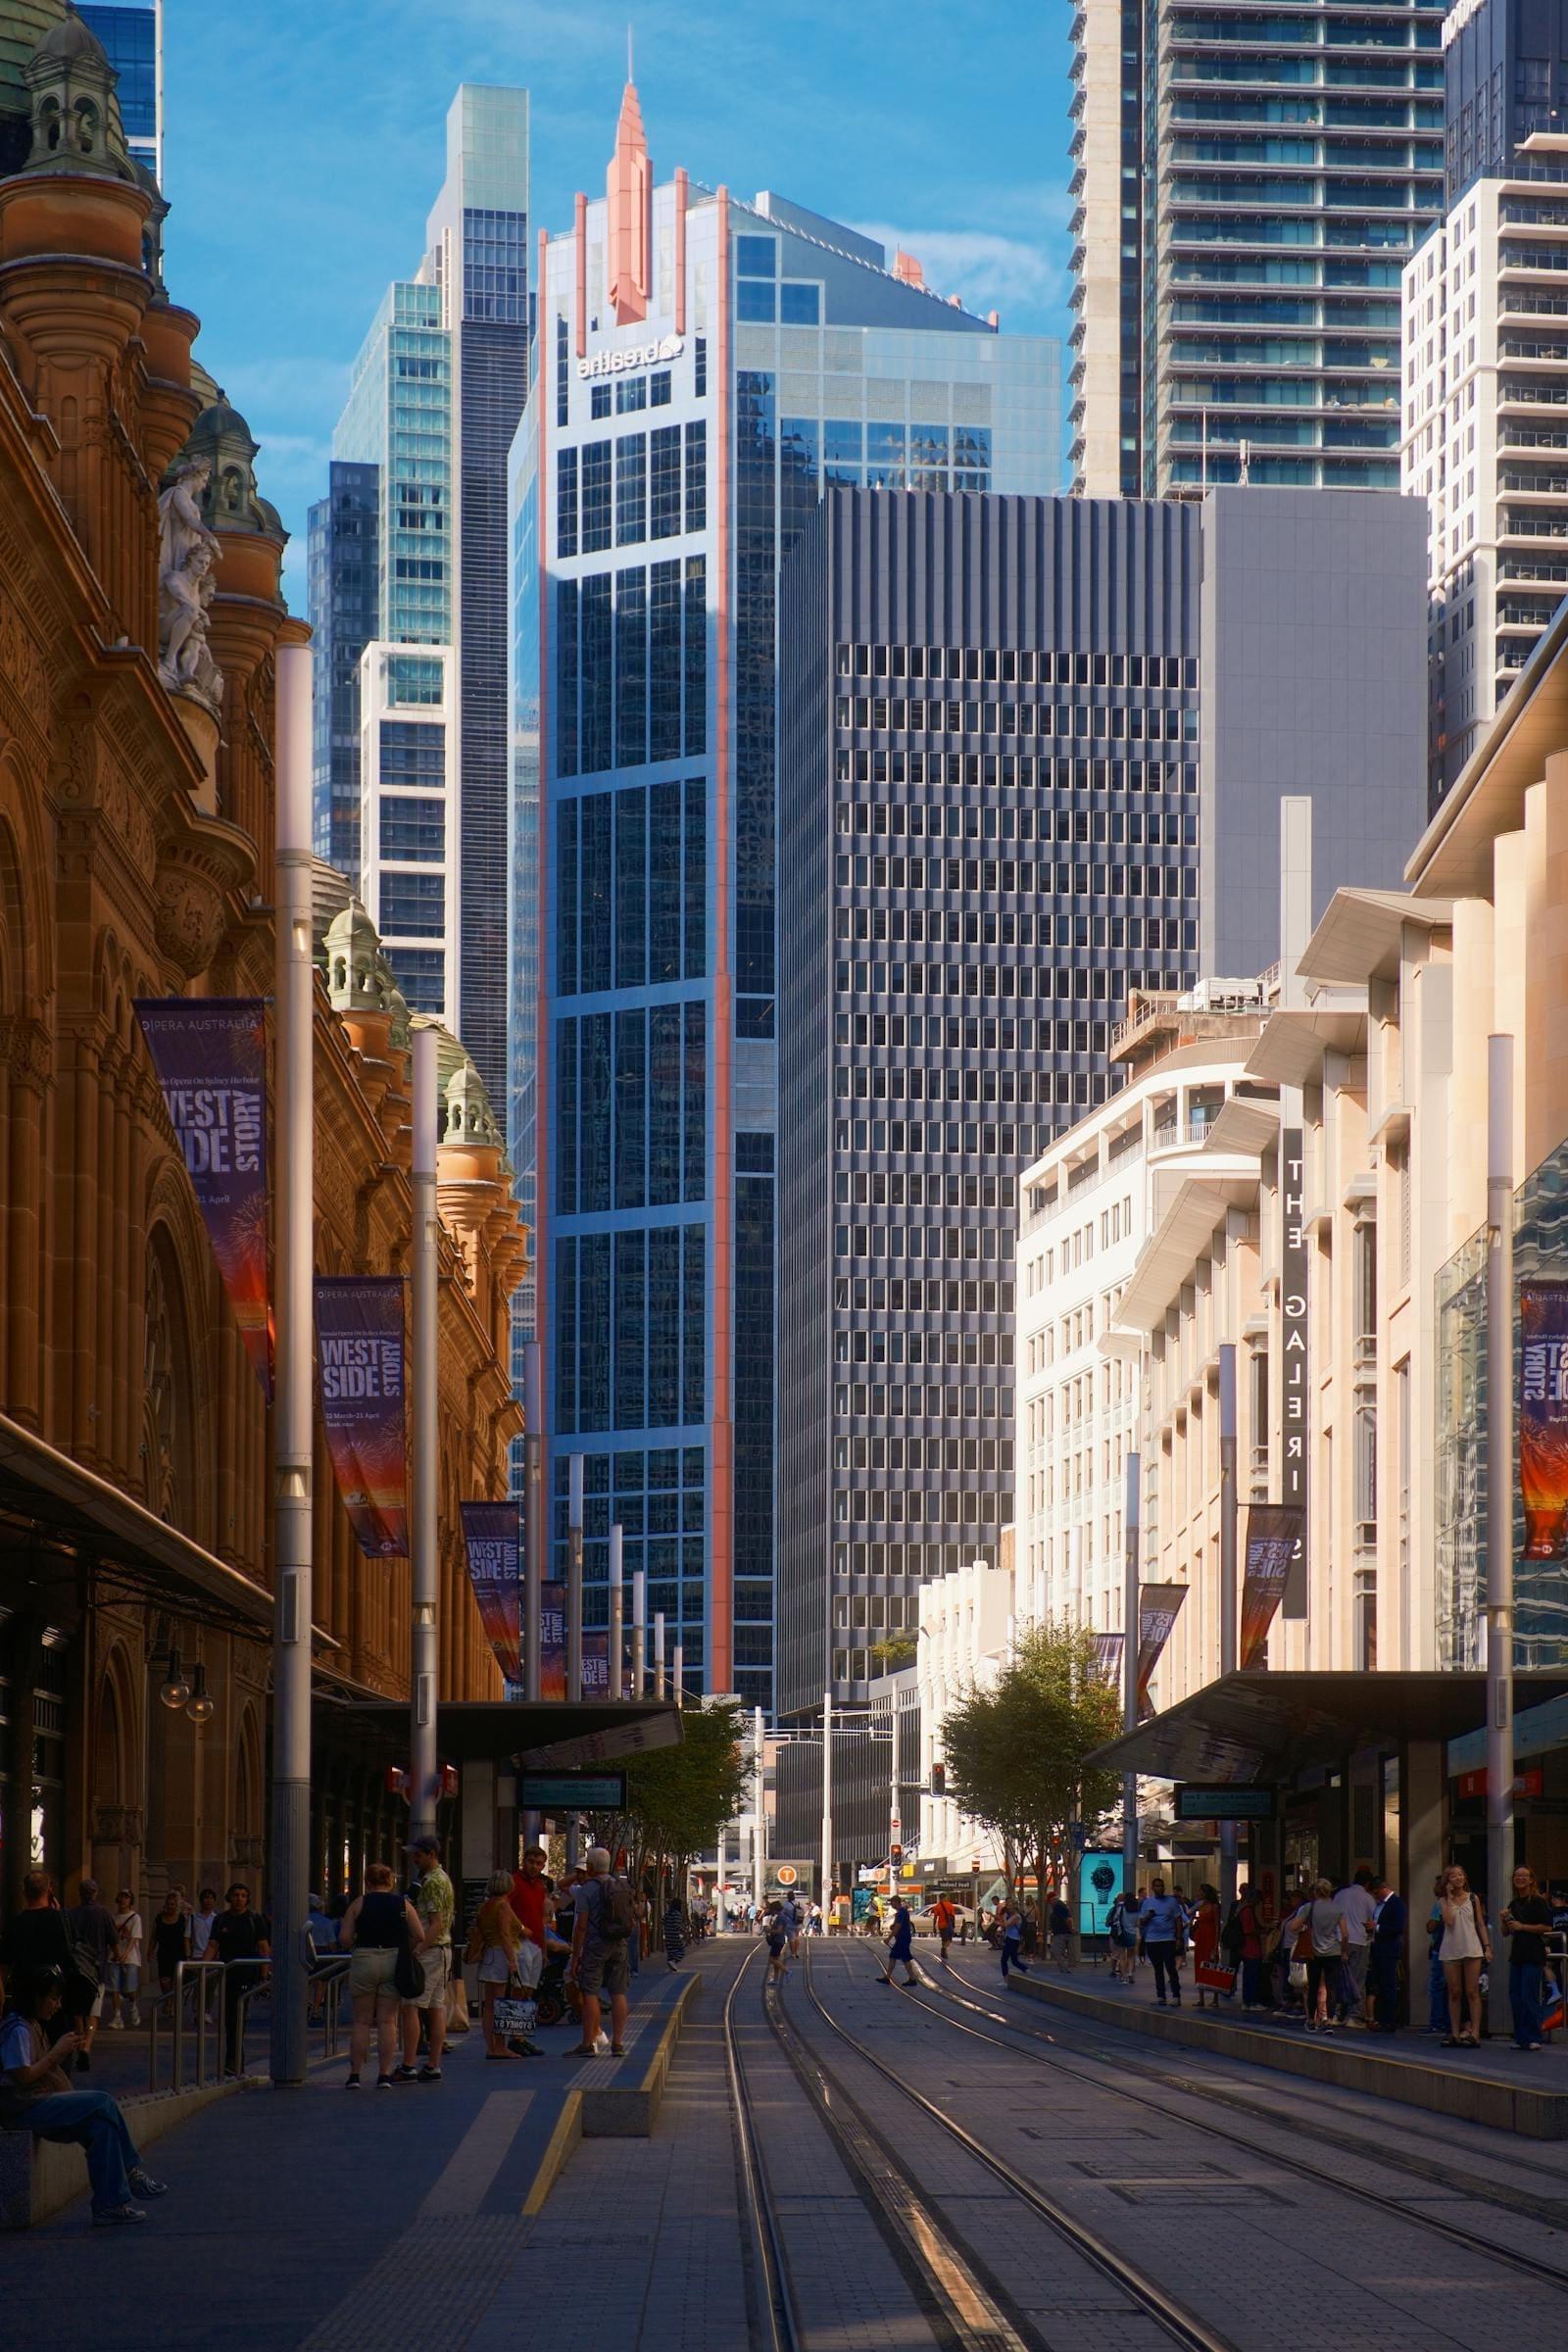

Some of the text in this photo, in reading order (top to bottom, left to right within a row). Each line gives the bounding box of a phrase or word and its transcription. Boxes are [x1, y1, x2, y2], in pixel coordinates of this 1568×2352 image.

[232, 1089, 261, 1172] STORY
[174, 1128, 231, 1172] DE
[320, 1339, 380, 1365] WEST
[380, 1339, 401, 1396] STORY
[323, 1365, 380, 1398] SIDE
[467, 1542, 503, 1559] WEST
[503, 1542, 518, 1580] STORY
[470, 1559, 503, 1581] SIDE
[581, 1658, 598, 1671] EST
[581, 1670, 598, 1685] DE
[783, 1870, 792, 1882] T
